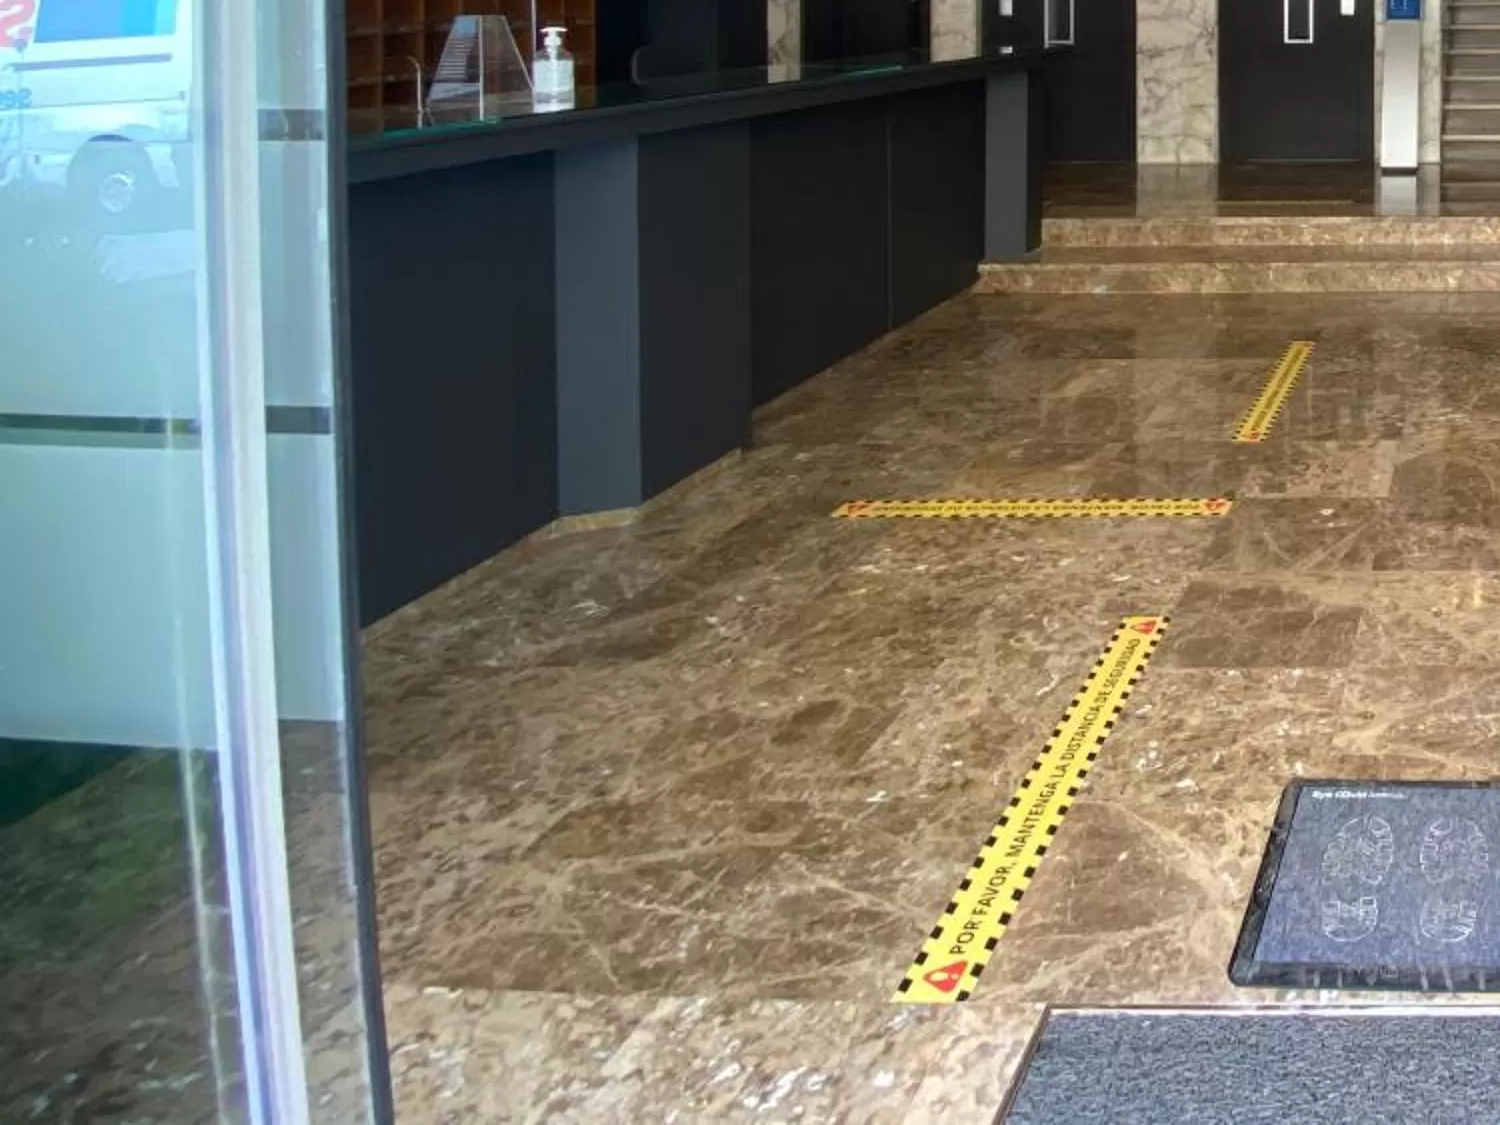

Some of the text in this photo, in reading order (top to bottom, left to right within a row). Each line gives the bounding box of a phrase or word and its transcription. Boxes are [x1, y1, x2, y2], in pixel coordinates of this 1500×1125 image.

[1060, 706, 1101, 760] DISTANCIA
[1050, 762, 1071, 779] LA
[1005, 779, 1060, 857] MANTENGA
[972, 862, 1016, 915] FAVOR,
[949, 920, 982, 954] POR
